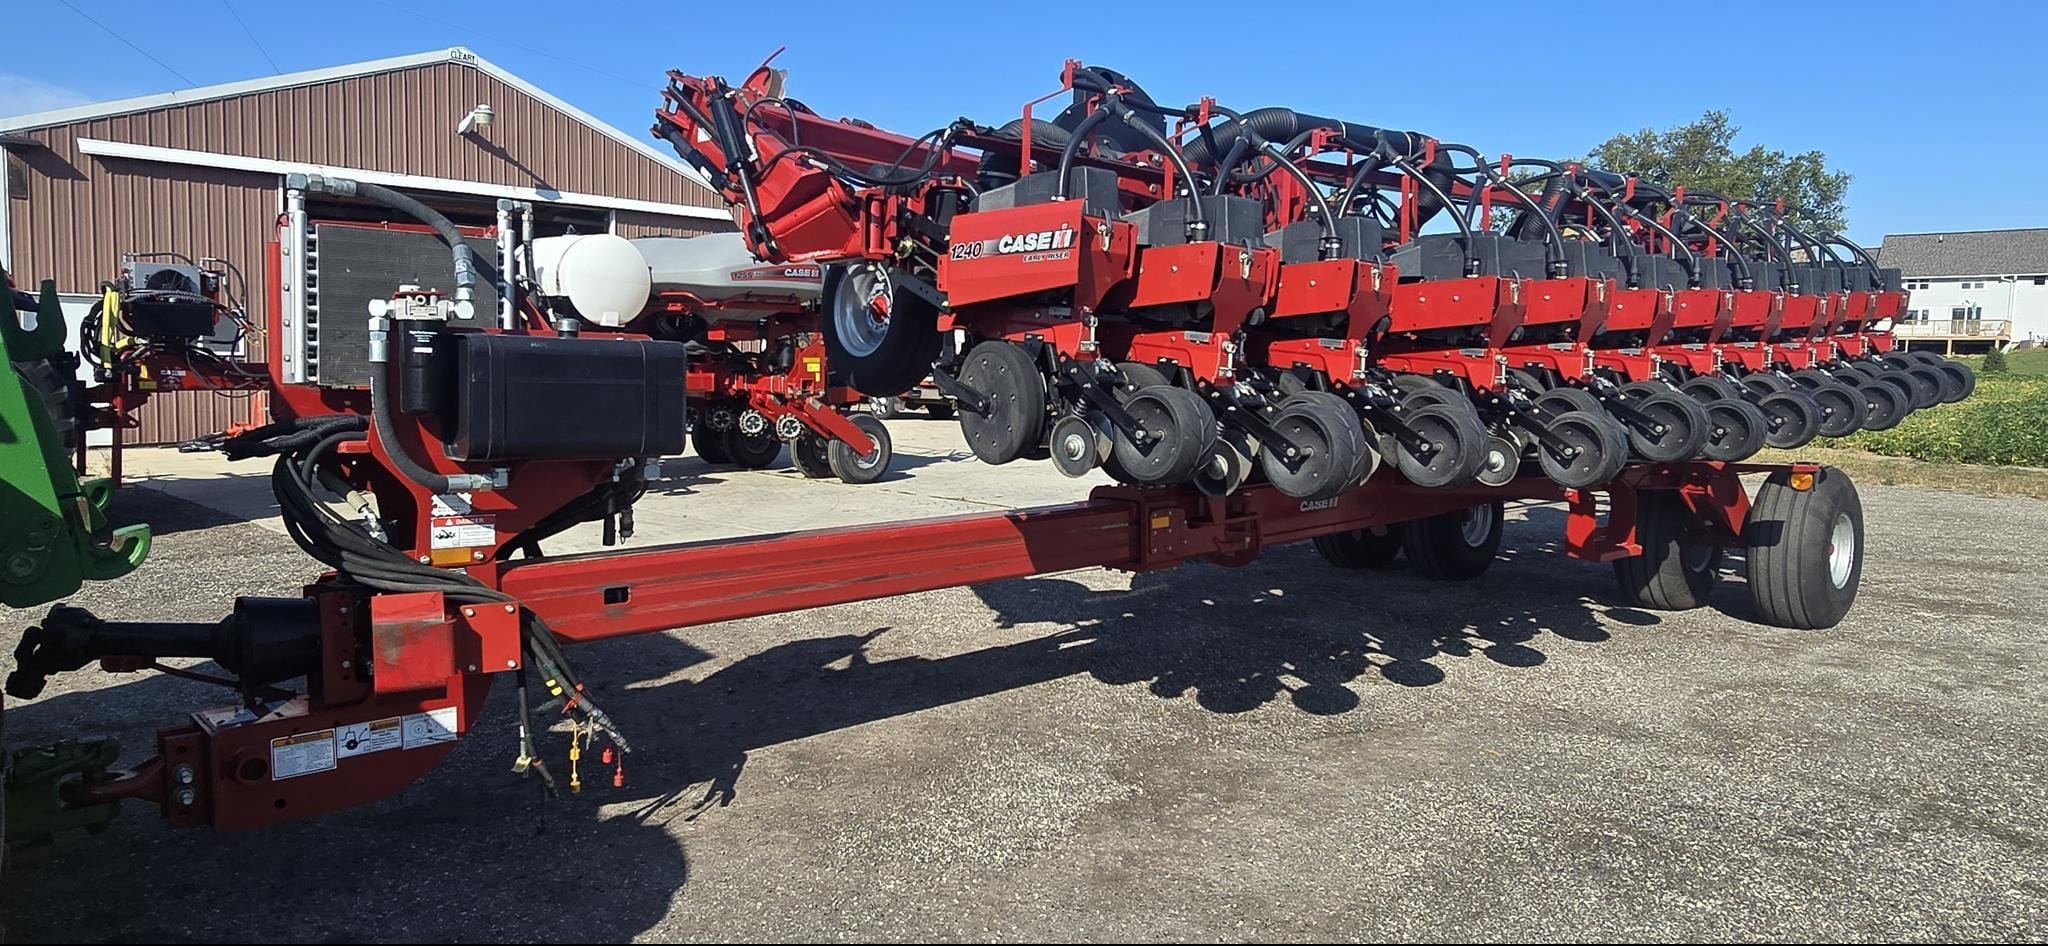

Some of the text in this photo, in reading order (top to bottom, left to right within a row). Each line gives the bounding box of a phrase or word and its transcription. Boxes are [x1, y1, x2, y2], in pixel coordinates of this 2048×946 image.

[999, 232, 1052, 253] CASE
[950, 241, 984, 260] 1240
[1047, 252, 1069, 260] RISER
[784, 268, 811, 277] CASE
[1300, 500, 1328, 512] CASE
